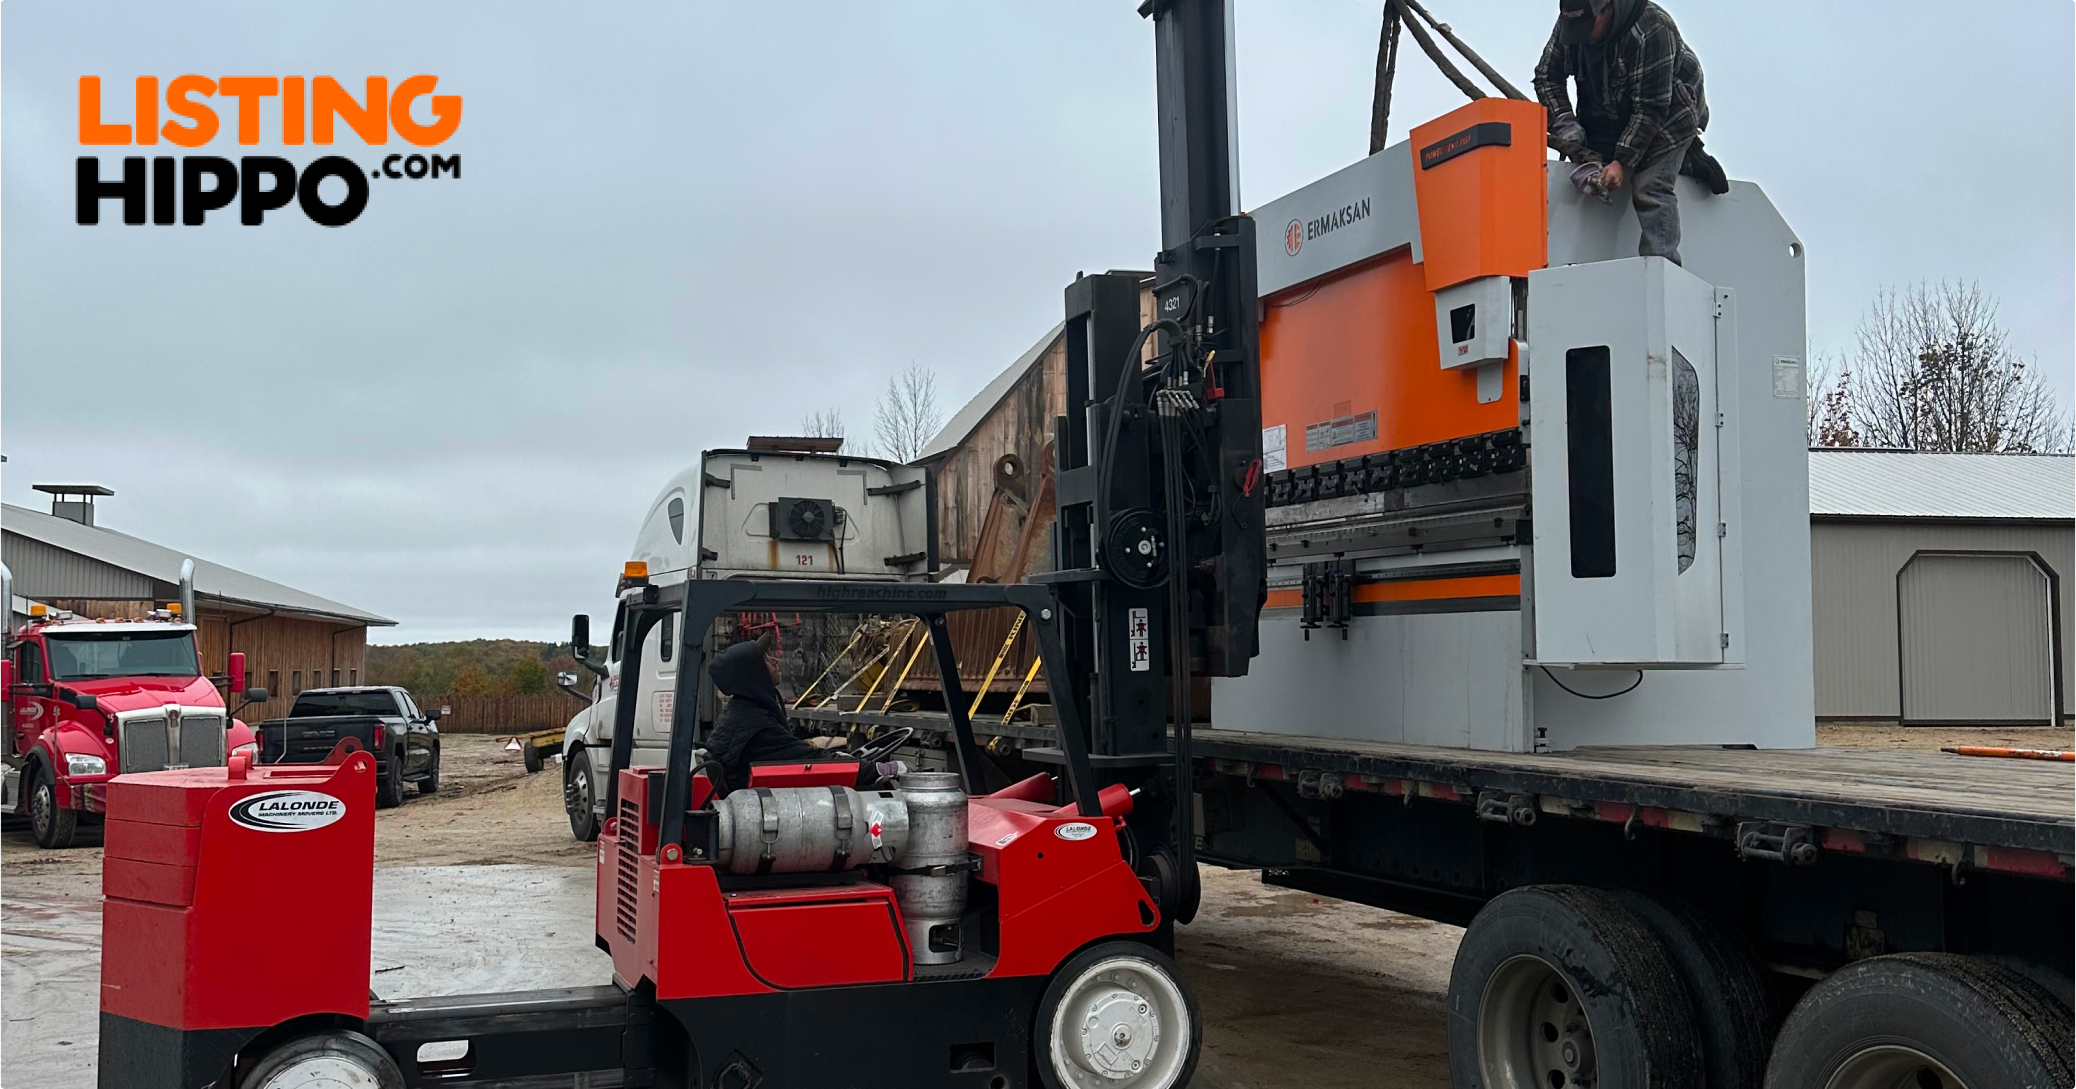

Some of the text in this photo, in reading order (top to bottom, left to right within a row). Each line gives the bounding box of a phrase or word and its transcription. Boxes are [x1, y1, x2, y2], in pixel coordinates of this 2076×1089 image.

[1307, 197, 1371, 241] ERMAKSAN
[1164, 295, 1180, 312] 4321
[795, 554, 814, 566] 121
[816, 585, 947, 599] highreachinc.com
[259, 801, 340, 811] LALONDE
